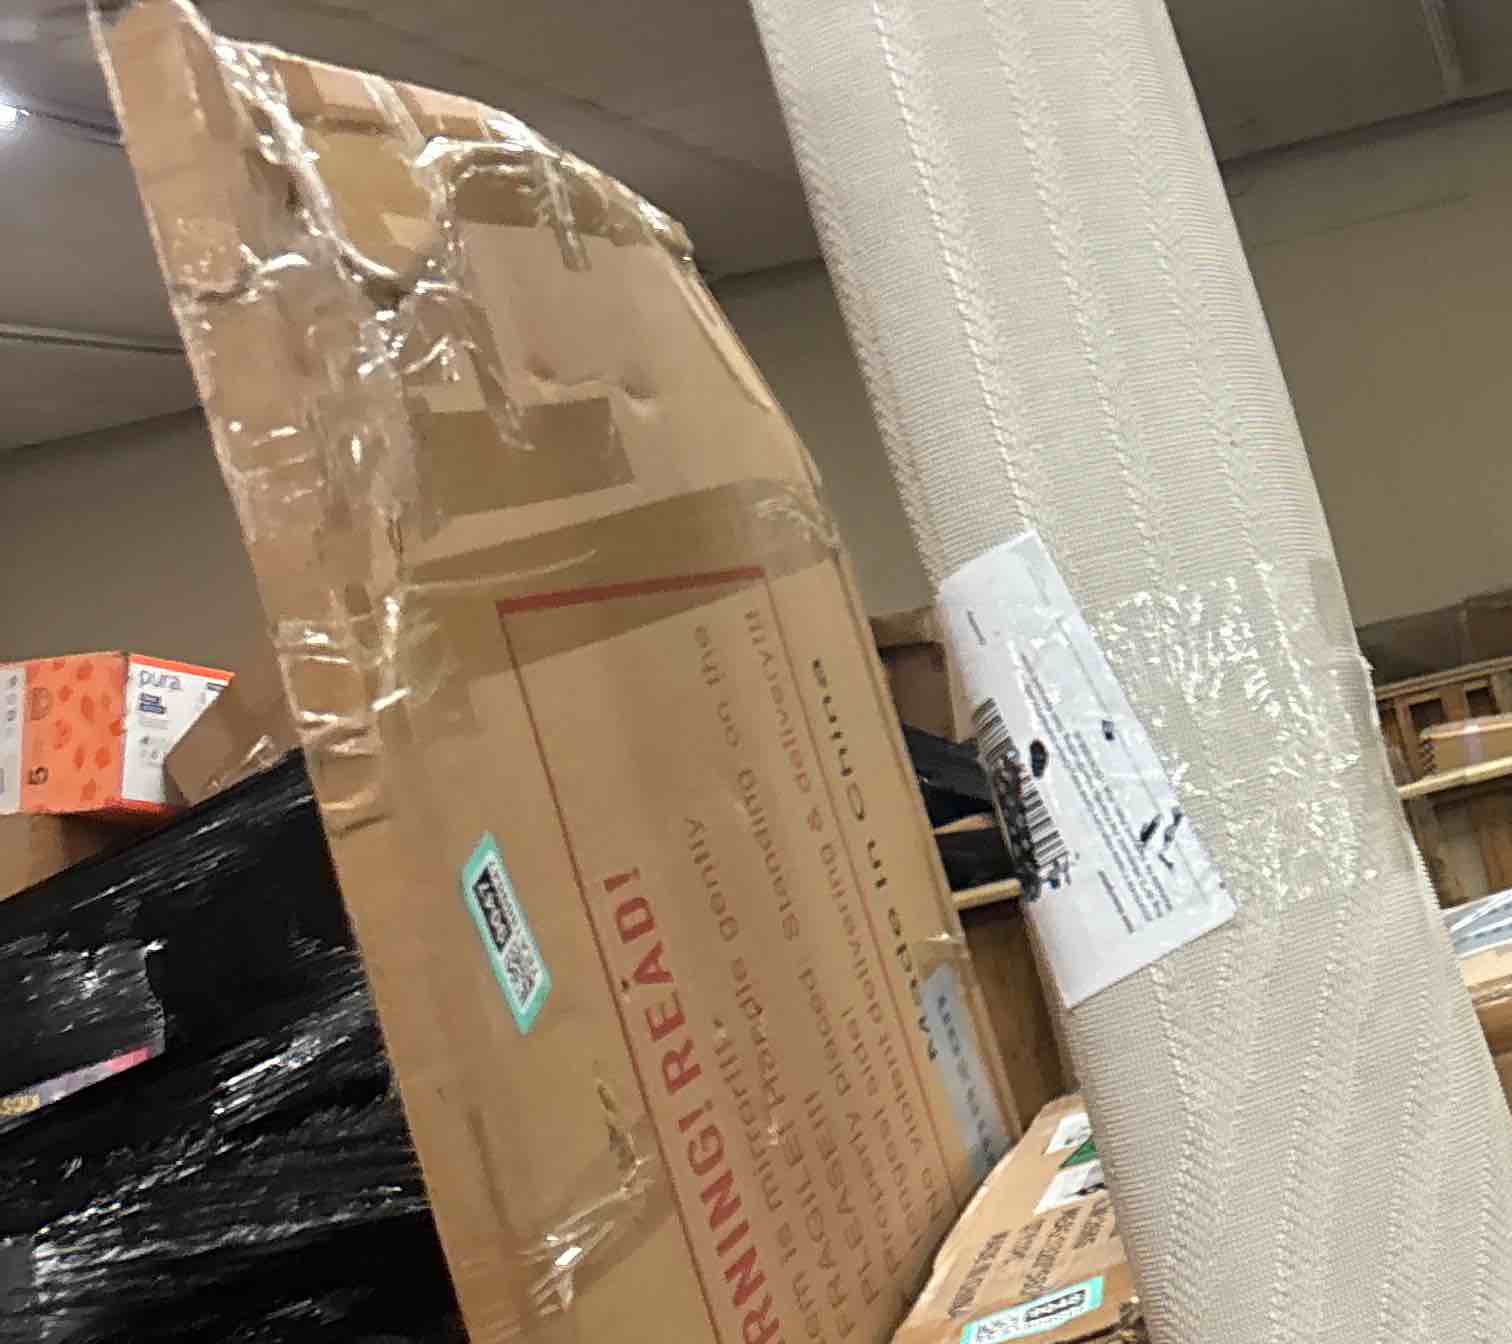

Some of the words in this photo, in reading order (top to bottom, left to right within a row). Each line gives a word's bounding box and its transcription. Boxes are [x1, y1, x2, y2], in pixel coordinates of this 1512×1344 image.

[139, 669, 182, 690] pura
[804, 654, 870, 823] China
[681, 817, 740, 943] gently
[730, 765, 802, 942] Standing
[602, 864, 704, 1095] READ!
[881, 905, 944, 1063] Made
[773, 1220, 799, 1266] is
